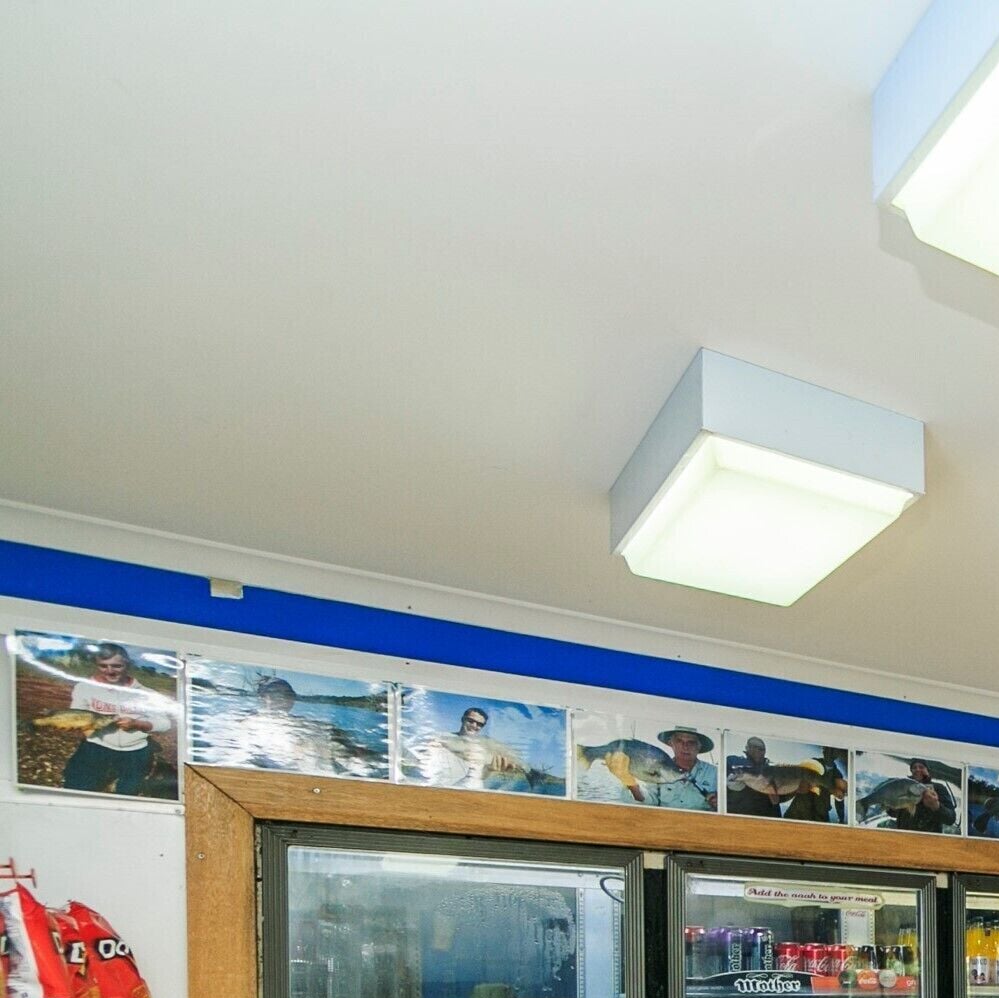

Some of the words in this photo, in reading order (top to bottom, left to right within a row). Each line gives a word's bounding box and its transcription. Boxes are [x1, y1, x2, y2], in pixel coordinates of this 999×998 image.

[748, 887, 772, 896] Add
[774, 889, 788, 897] the
[855, 896, 879, 904] meal
[731, 942, 743, 972] other
[734, 978, 801, 994] Mother
